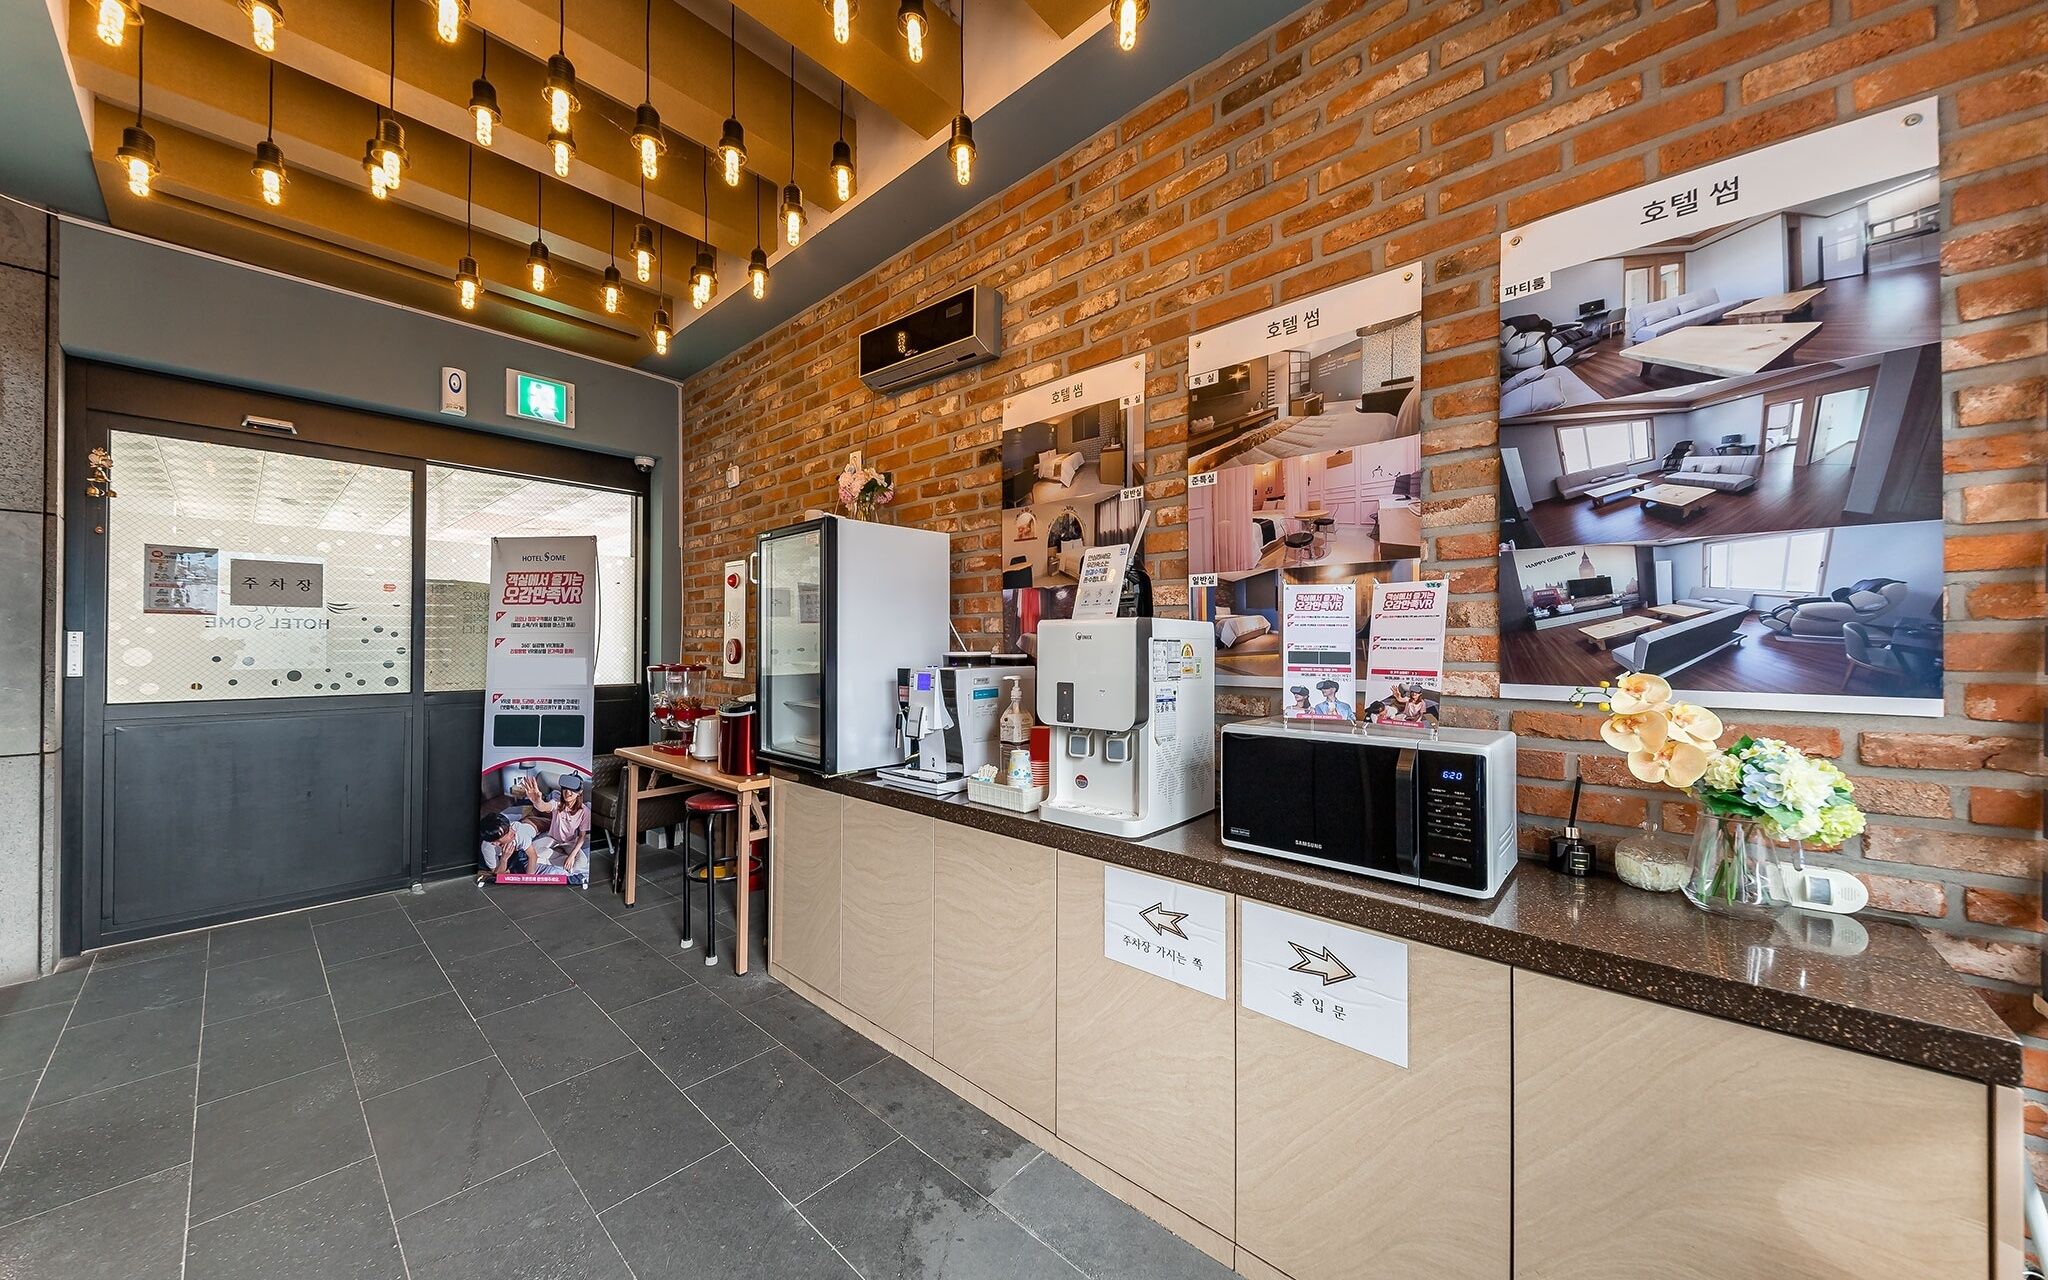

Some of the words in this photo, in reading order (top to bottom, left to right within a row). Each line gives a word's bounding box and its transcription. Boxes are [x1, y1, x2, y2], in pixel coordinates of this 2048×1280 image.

[1640, 188, 1699, 225] 호텔
[1709, 176, 1740, 207] 썸
[1504, 276, 1546, 297] 파티룸
[1266, 314, 1298, 340] 호텔
[1303, 308, 1320, 330] 썸
[1051, 386, 1070, 405] 호텔
[1072, 382, 1083, 399] 썸
[1191, 474, 1215, 486] 준특실
[1123, 487, 1142, 499] 일반실
[1525, 559, 1546, 569] HAPPY
[1546, 555, 1564, 563] GOOD
[1564, 550, 1576, 558] TIME
[507, 572, 550, 587] 객실에서
[551, 572, 583, 587] 즐기는
[1192, 575, 1216, 586] 일반실
[503, 586, 582, 604] 오감만족VR
[1442, 770, 1463, 781] 6:20
[1295, 839, 1323, 850] SAMSUNG
[1123, 934, 1151, 954] 주차장
[1155, 944, 1187, 966] 가시는
[1192, 957, 1203, 971] 쪽
